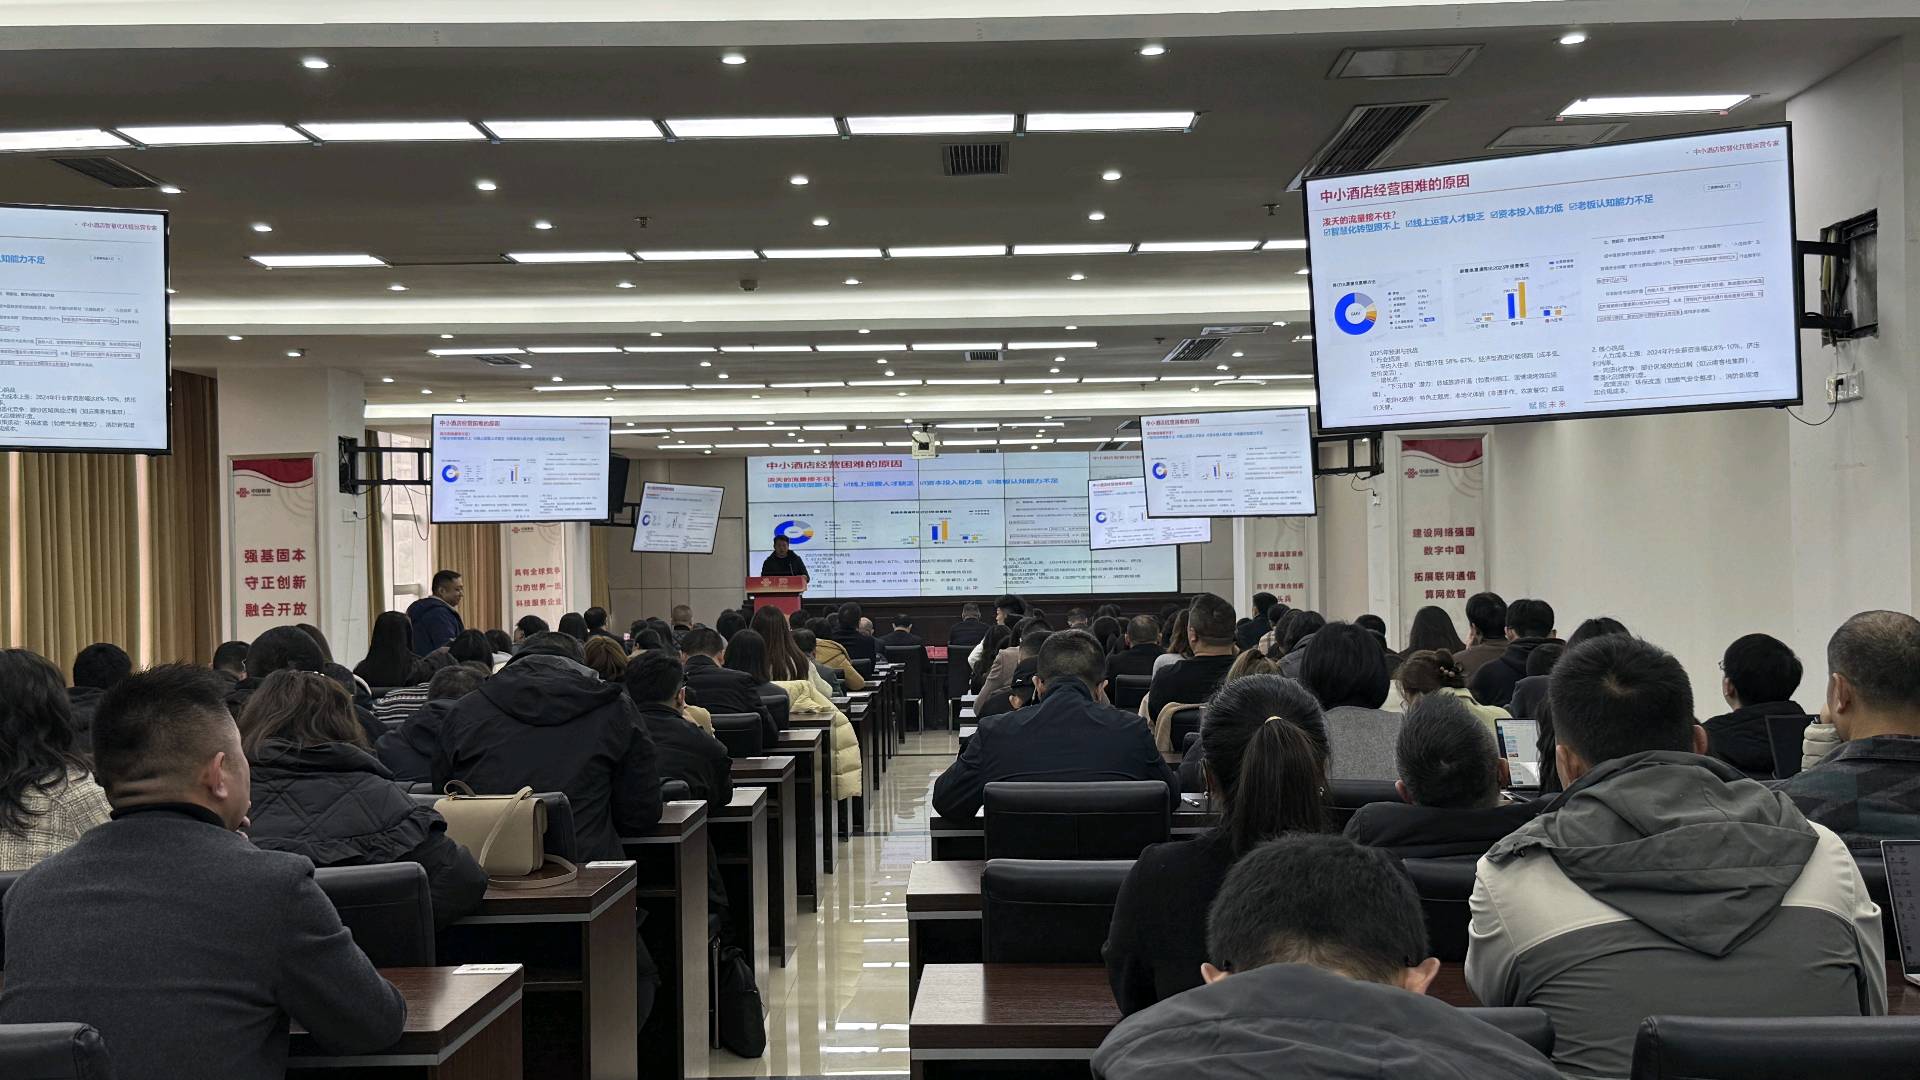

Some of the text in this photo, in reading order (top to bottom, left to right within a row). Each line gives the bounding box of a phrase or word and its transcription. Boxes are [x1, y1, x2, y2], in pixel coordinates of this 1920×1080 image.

[1320, 174, 1470, 203] 中小酒店经营困难的原因
[1412, 212, 1485, 228] 线上运营人才缺乏
[1498, 202, 1564, 219] 资本投入能力低
[1576, 193, 1654, 211] 老板认知能力不足
[0, 254, 46, 265] 知能力不足
[766, 459, 903, 470] 中小酒店经营困难的原因
[1412, 526, 1476, 538] 建设网络强国
[244, 548, 306, 564] 强基固本
[1423, 545, 1465, 556] 数字中国
[1268, 563, 1290, 571] 国家队
[244, 575, 307, 590] 守正创新
[1413, 570, 1477, 583] 拓展联网通信
[515, 582, 562, 592] 力的世界一流
[1424, 589, 1467, 600] 算网数智
[245, 601, 308, 618] 融合开放
